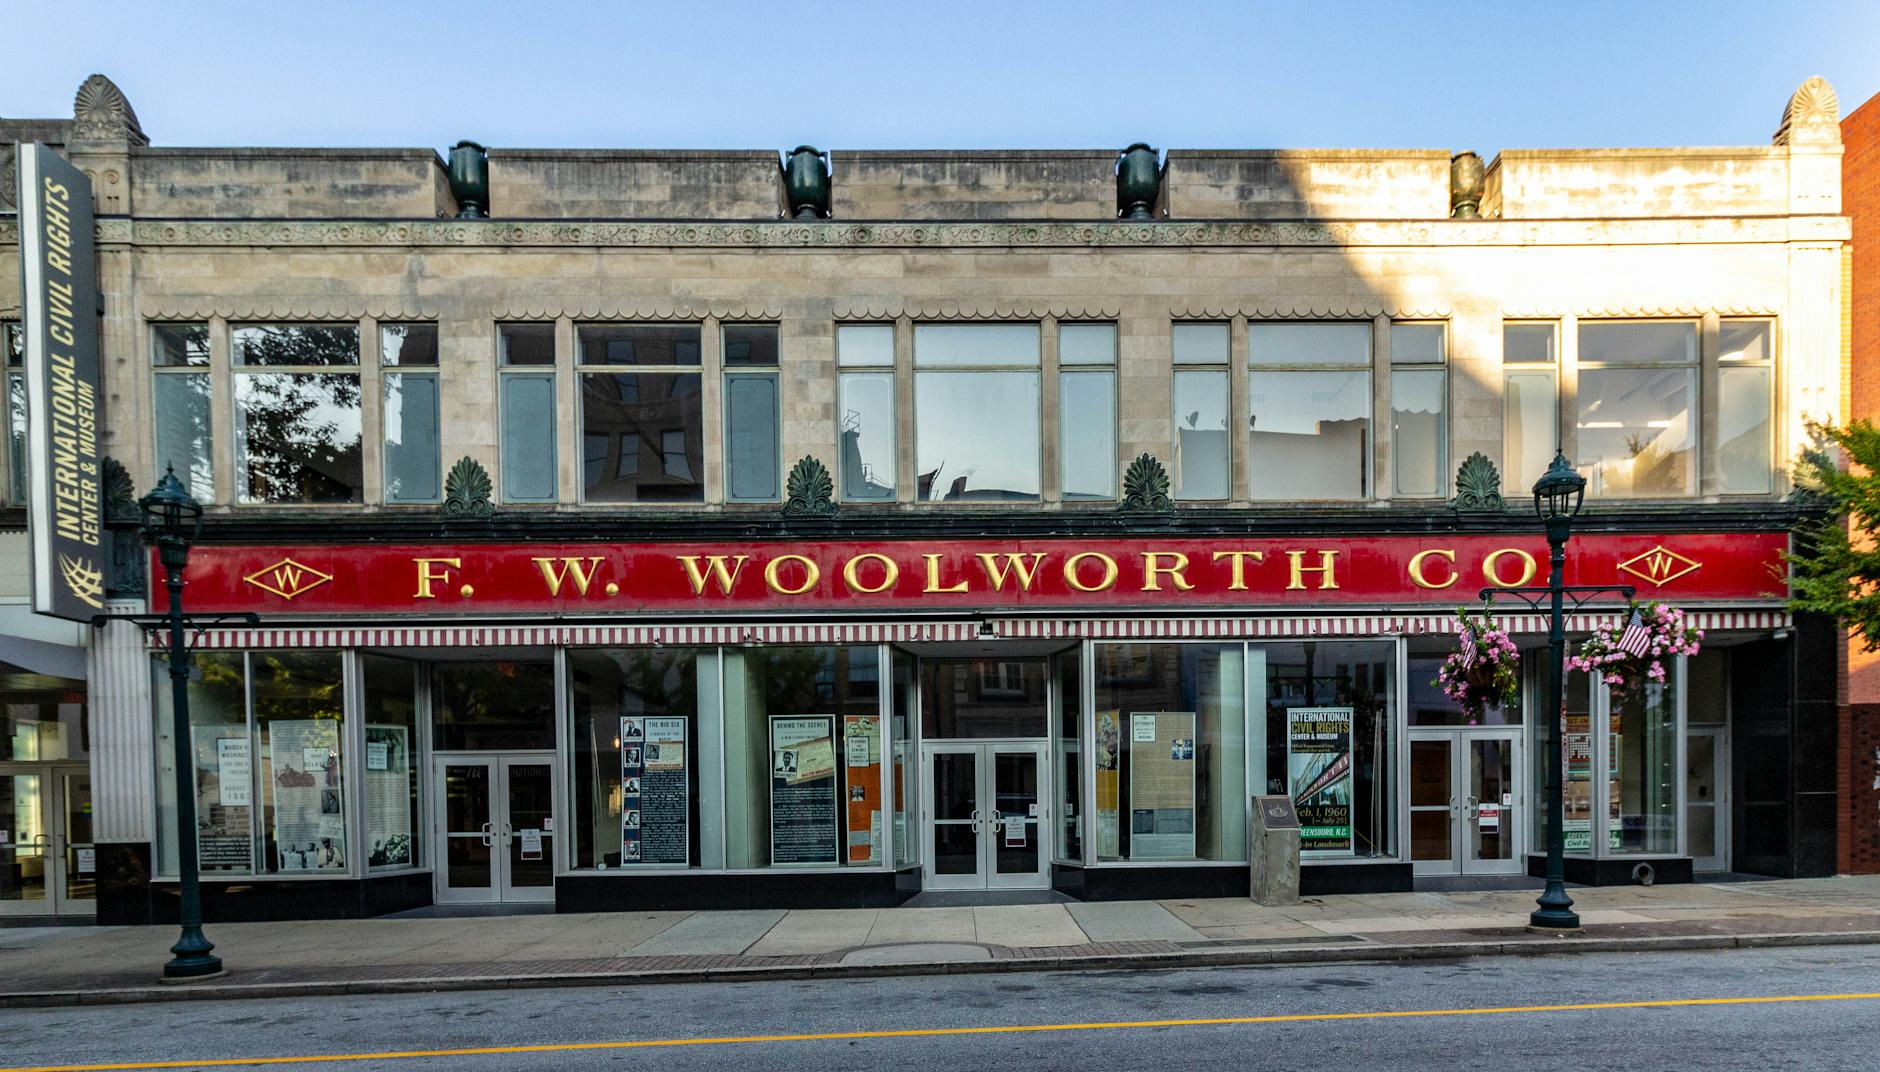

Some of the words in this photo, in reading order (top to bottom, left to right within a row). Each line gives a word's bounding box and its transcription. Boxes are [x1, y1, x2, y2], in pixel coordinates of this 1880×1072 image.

[44, 177, 72, 276] RIGHTS
[49, 279, 74, 346] CIVIL
[78, 379, 97, 458] MUSEUM
[51, 353, 80, 541] INTERNATIONAL
[80, 462, 97, 476] &
[81, 479, 99, 546] CENTER
[412, 557, 474, 599] F.
[531, 556, 620, 598] W.
[675, 551, 1341, 596] WOOLWORTH
[1291, 712, 1350, 722] INTERNATIONAL
[1291, 722, 1313, 734] CIVIL
[1316, 722, 1349, 734] RIGHTS
[1300, 828, 1335, 837] REENSBORO,
[1324, 807, 1347, 818] 1960
